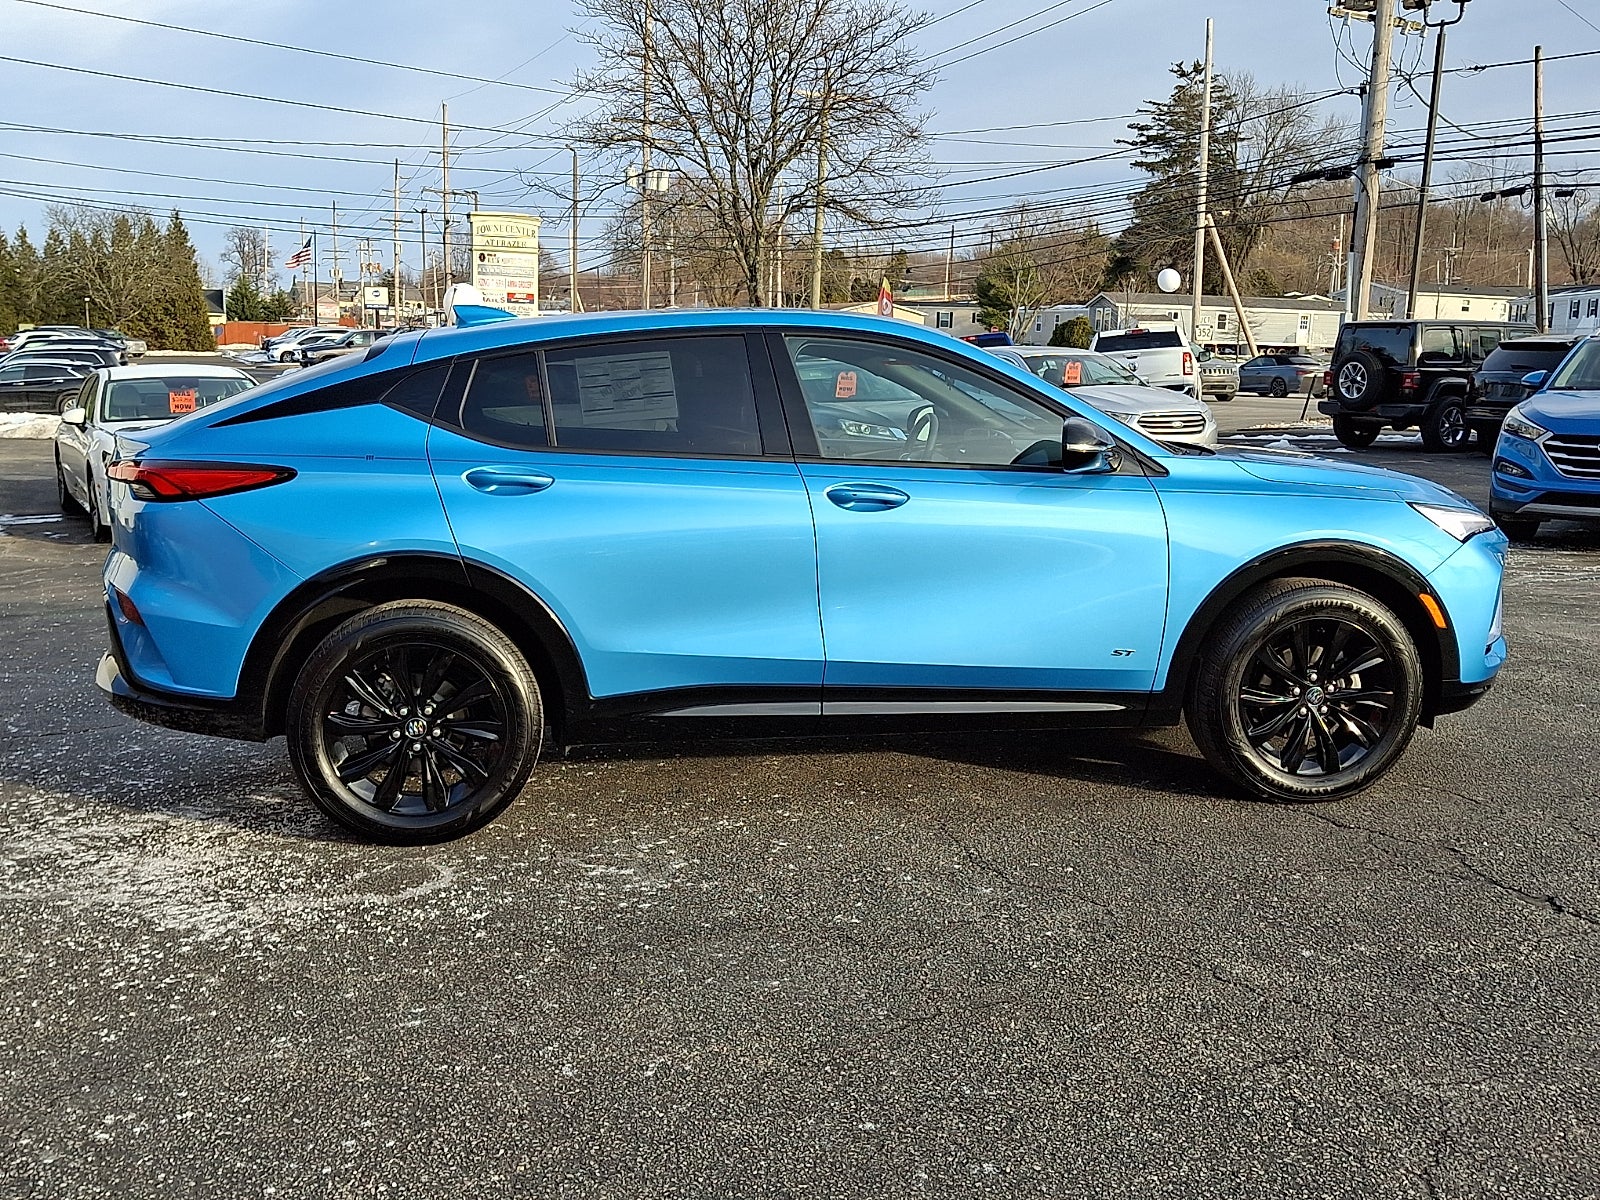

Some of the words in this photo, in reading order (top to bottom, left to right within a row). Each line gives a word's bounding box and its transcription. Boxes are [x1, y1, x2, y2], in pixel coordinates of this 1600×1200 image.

[476, 224, 503, 235] TOWNE
[506, 225, 536, 238] CENTER
[1197, 328, 1211, 338] 352
[1110, 649, 1136, 657] ST
